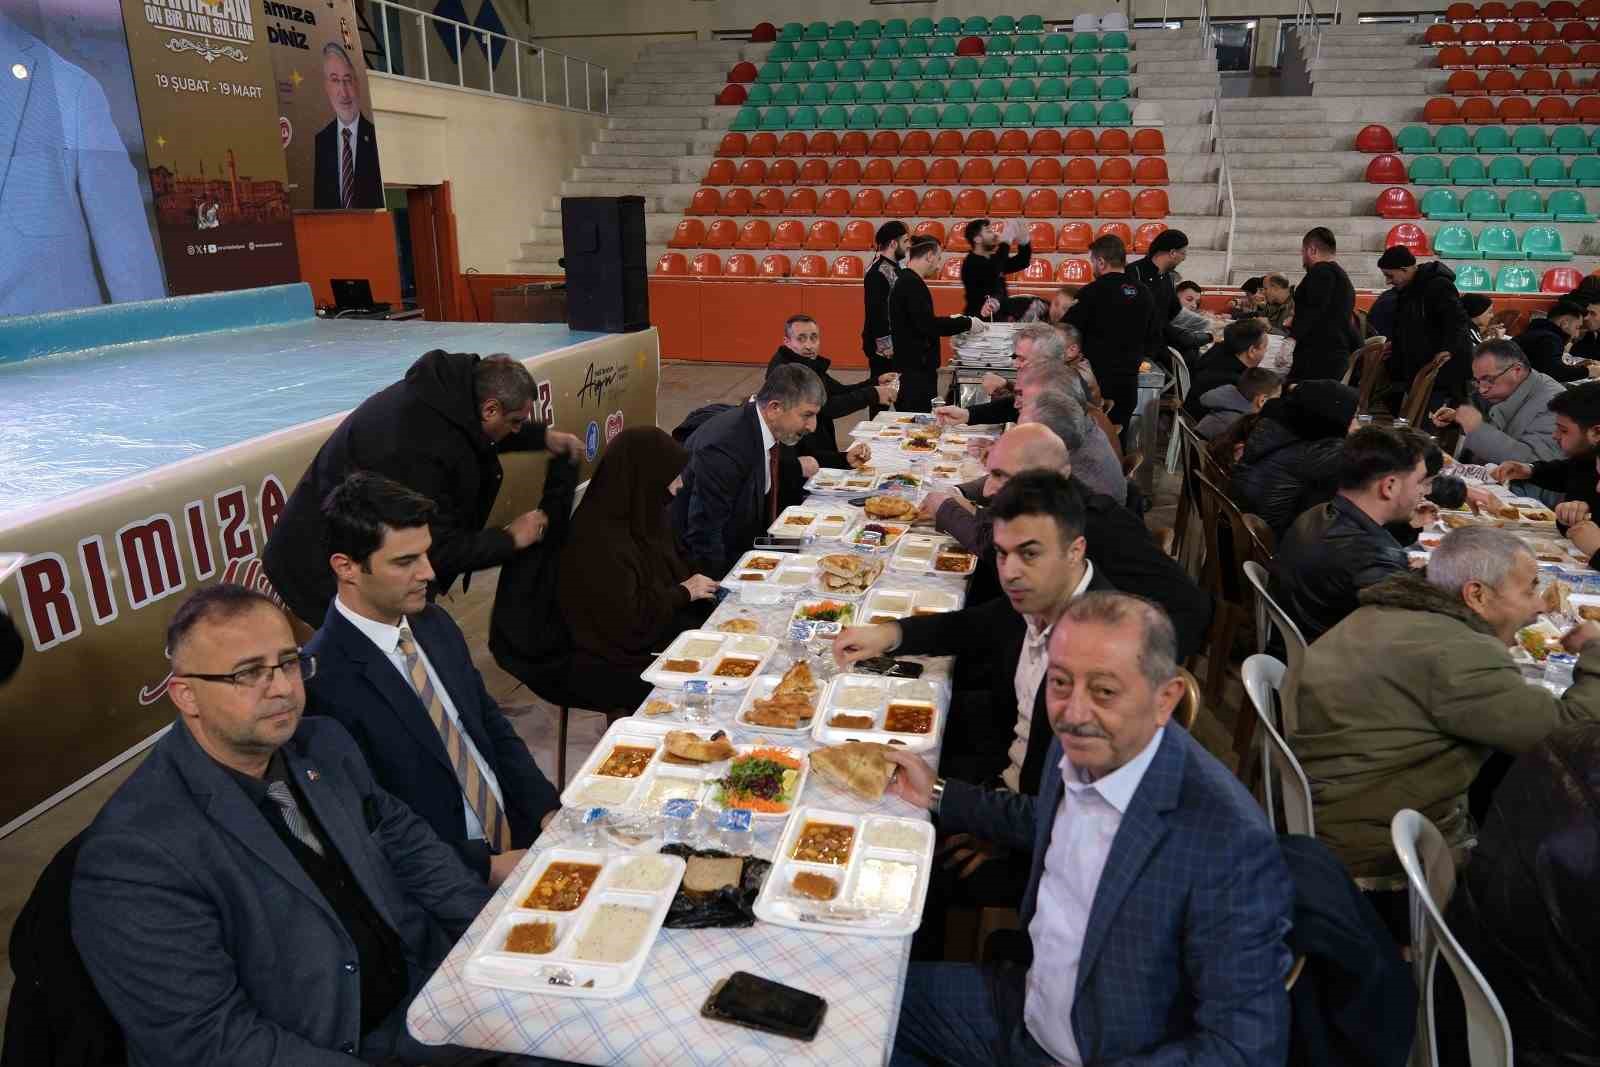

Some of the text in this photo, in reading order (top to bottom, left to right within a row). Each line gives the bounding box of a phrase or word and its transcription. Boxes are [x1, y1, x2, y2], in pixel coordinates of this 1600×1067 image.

[144, 5, 162, 24] ON
[155, 73, 169, 88] 19
[170, 76, 209, 93] ŞUBAT
[219, 82, 231, 95] 19
[232, 84, 262, 98] MART
